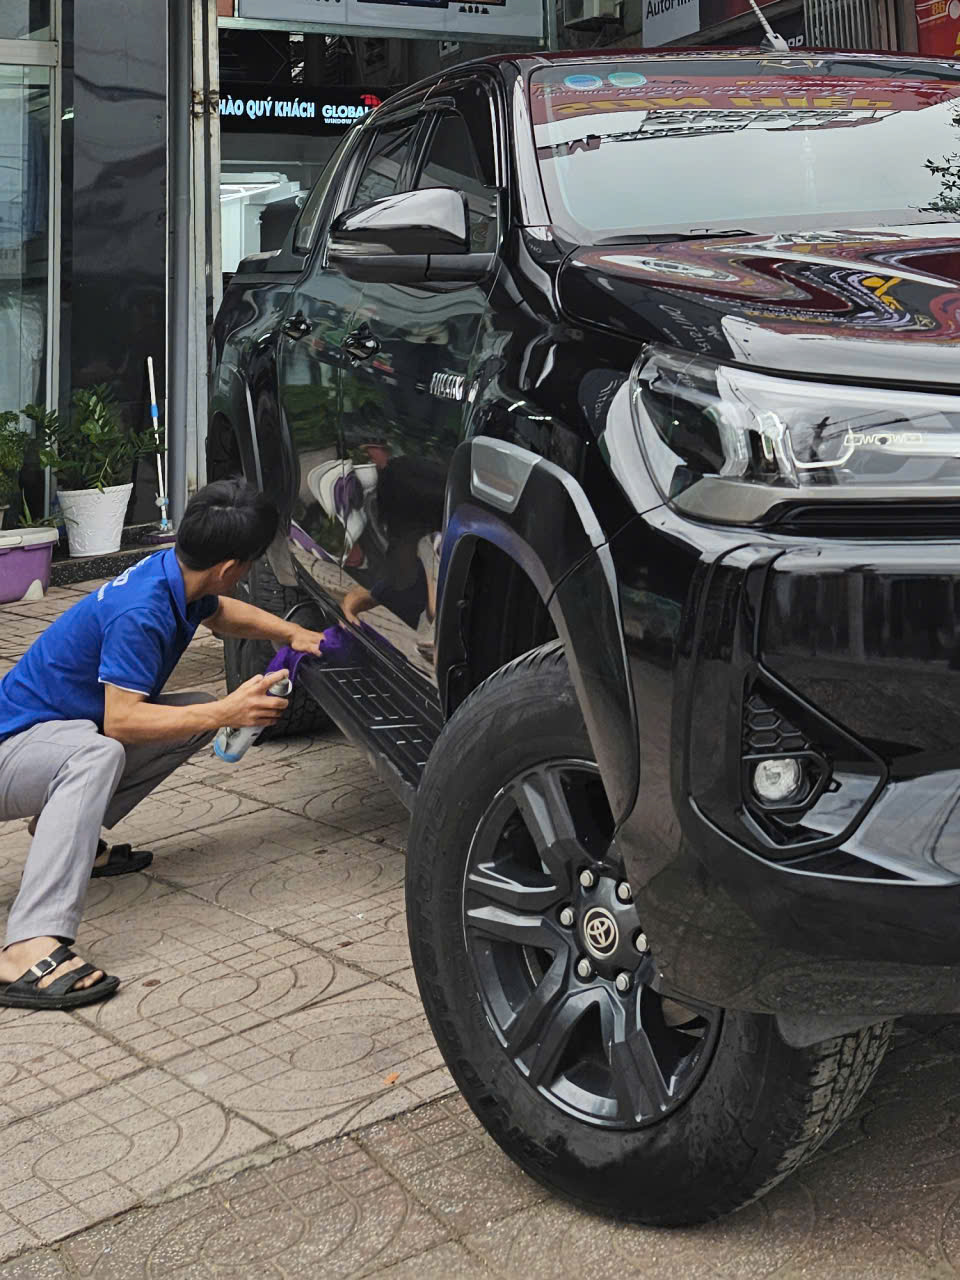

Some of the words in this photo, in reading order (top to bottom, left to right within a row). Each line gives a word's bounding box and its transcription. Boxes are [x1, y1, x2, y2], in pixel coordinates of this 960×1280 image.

[218, 95, 245, 116] HÀO
[246, 96, 273, 120] QUÝ
[274, 97, 316, 118] KHÁCH
